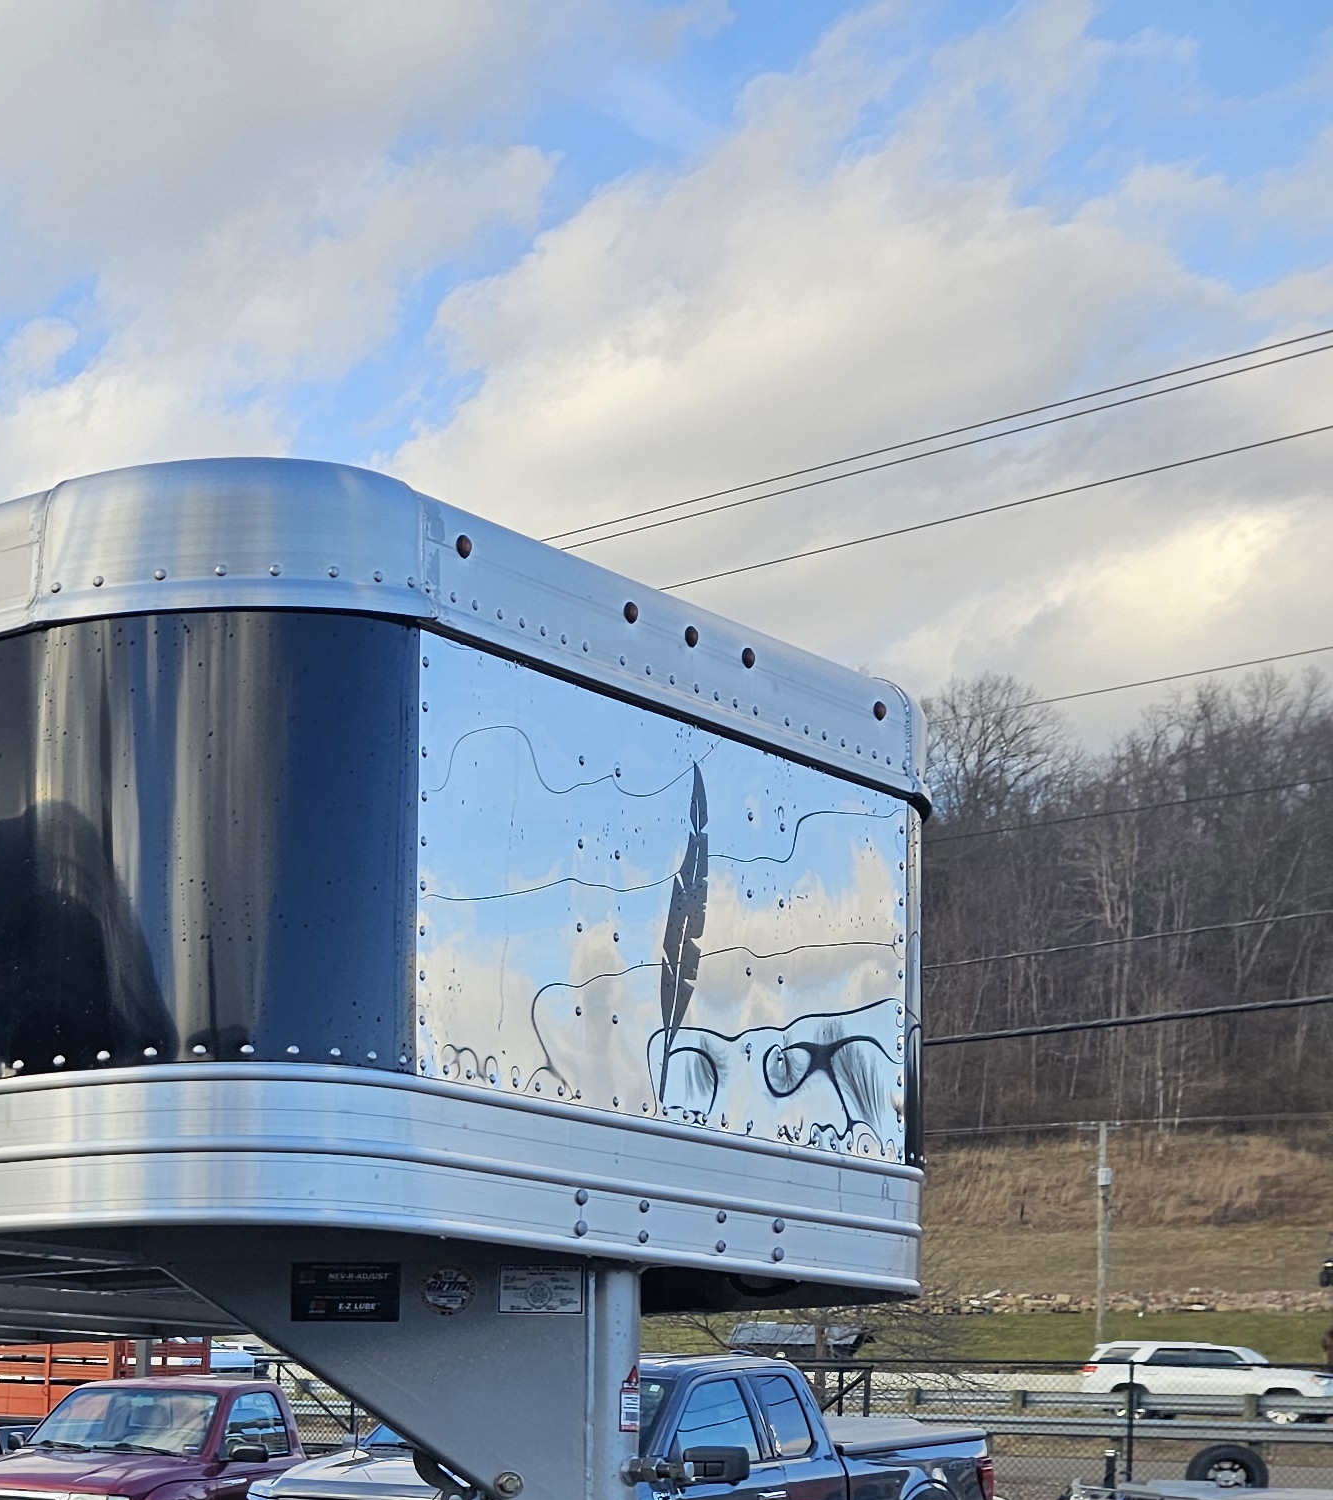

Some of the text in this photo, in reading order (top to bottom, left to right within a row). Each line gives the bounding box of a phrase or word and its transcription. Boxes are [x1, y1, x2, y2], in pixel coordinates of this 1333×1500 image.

[328, 1272, 389, 1280] NEV-R-ADJUST
[338, 1302, 377, 1310] E-Z LUBE
